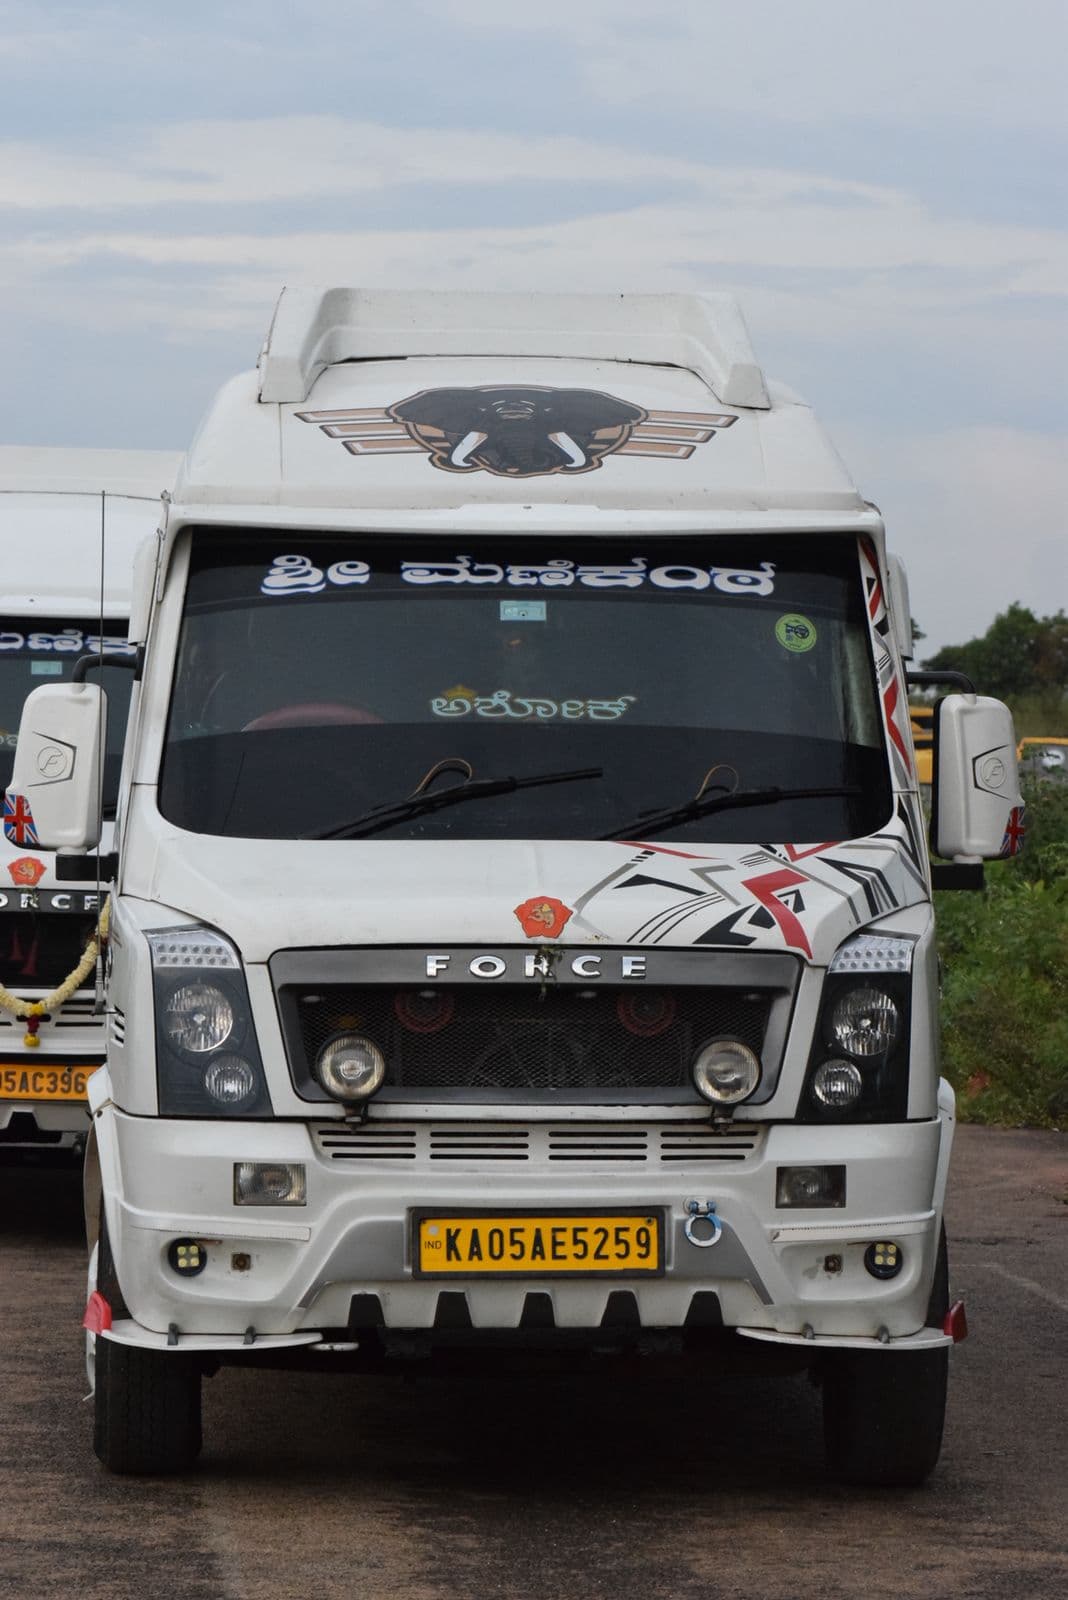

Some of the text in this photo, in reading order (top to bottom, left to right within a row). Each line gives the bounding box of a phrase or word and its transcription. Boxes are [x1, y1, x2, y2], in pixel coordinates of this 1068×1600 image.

[261, 555, 777, 596] ಶ್ರೀ ಮಣಿಕಂಠ
[431, 690, 637, 719] ಅಶೋಕ್
[426, 955, 647, 980] FORCE
[0, 1070, 95, 1094] 5AC396
[424, 1226, 651, 1262] IND KA05AE5259
